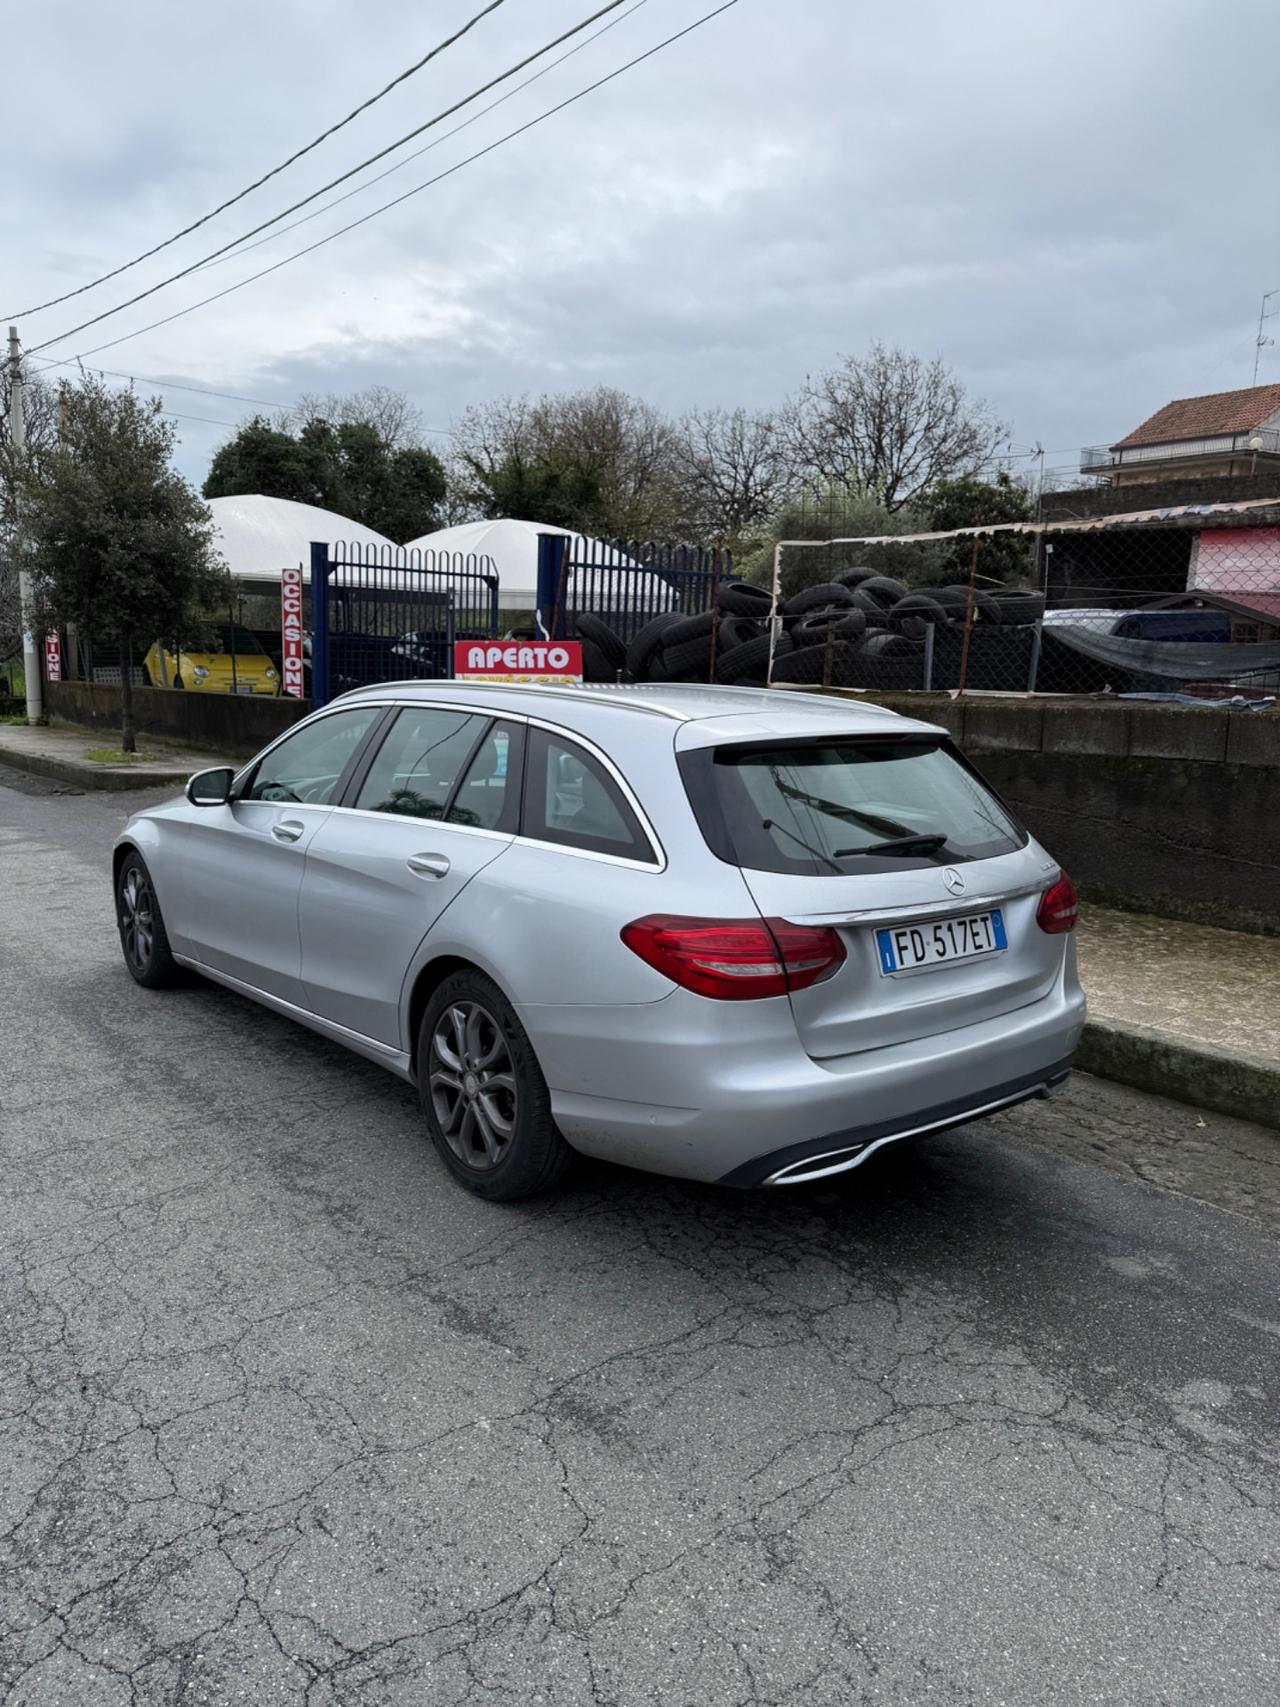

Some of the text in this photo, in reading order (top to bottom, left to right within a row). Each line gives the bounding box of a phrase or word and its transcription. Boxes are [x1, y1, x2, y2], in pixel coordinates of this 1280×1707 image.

[283, 570, 301, 698] OCCASIONE
[468, 647, 569, 669] APERTO
[895, 917, 992, 965] FD 517ET
